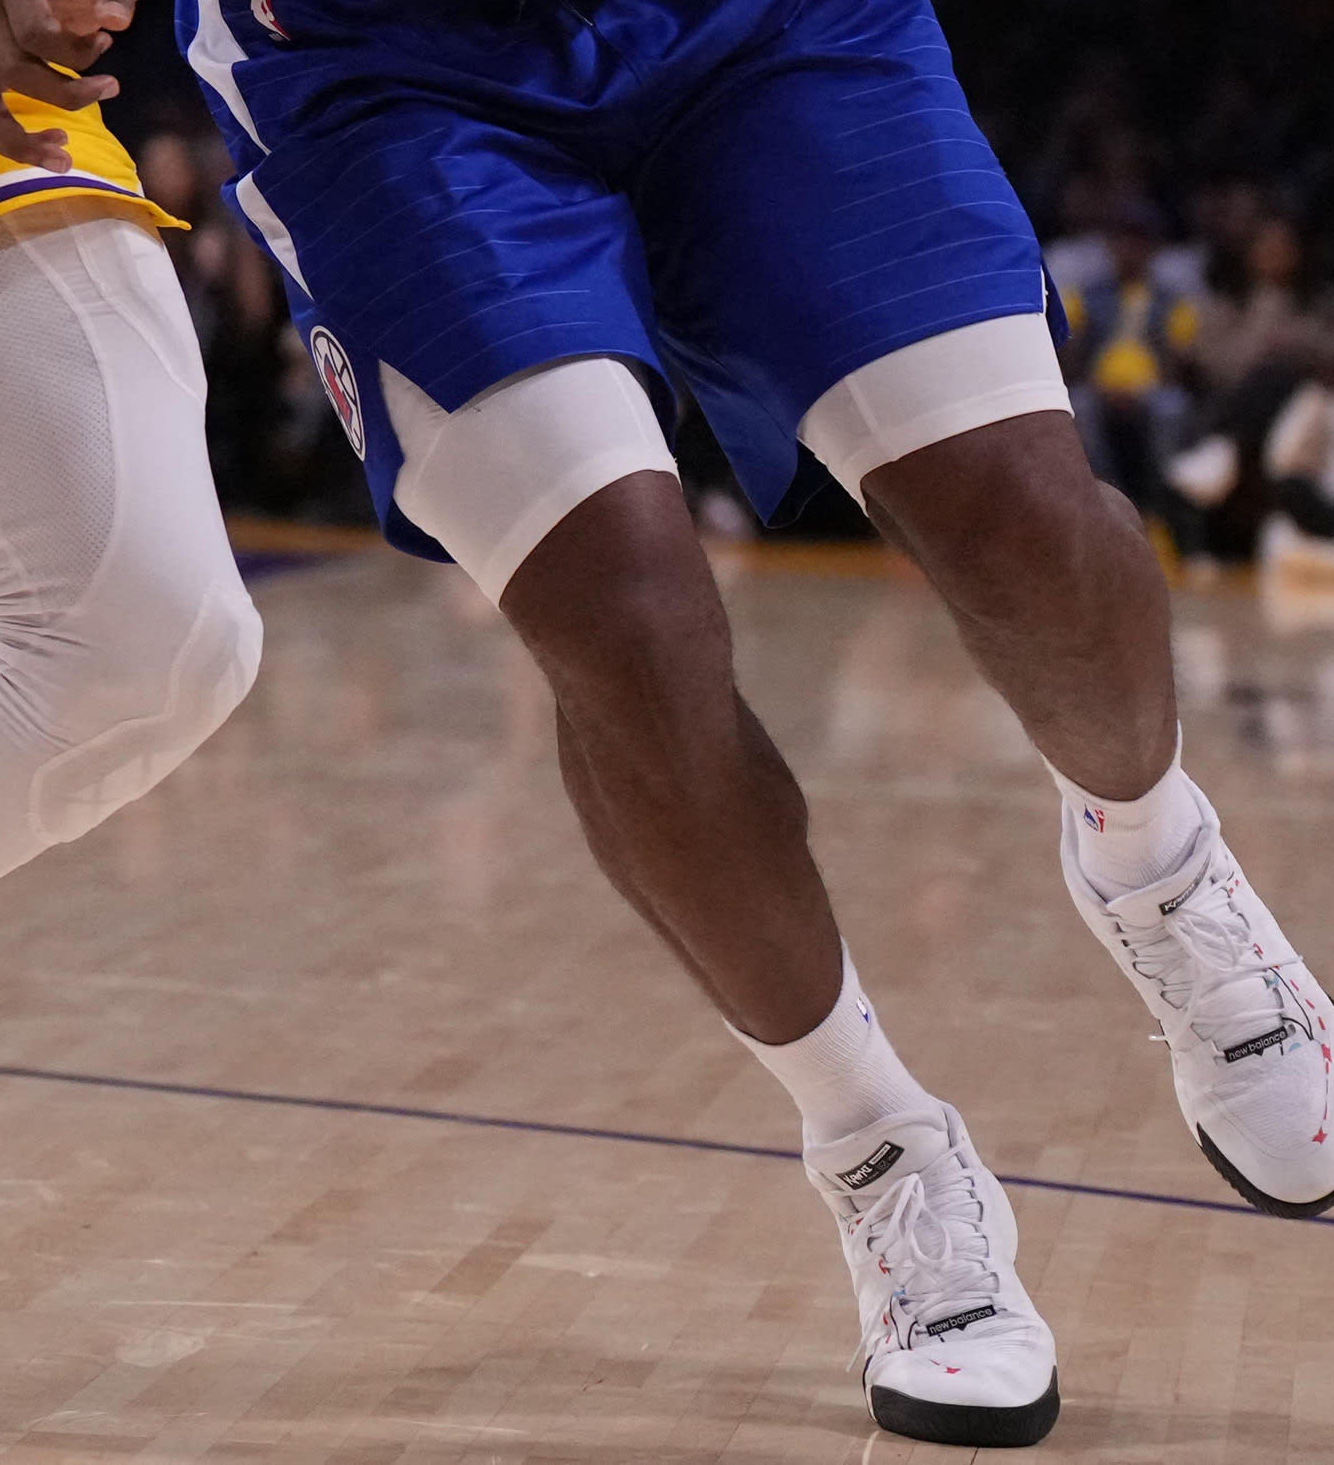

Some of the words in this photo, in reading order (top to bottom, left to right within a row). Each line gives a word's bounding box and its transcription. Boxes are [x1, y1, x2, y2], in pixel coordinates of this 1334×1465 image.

[1228, 1047, 1248, 1060] new
[1248, 1031, 1286, 1052] balance
[929, 1320, 949, 1334] new
[950, 1308, 993, 1326] balance
